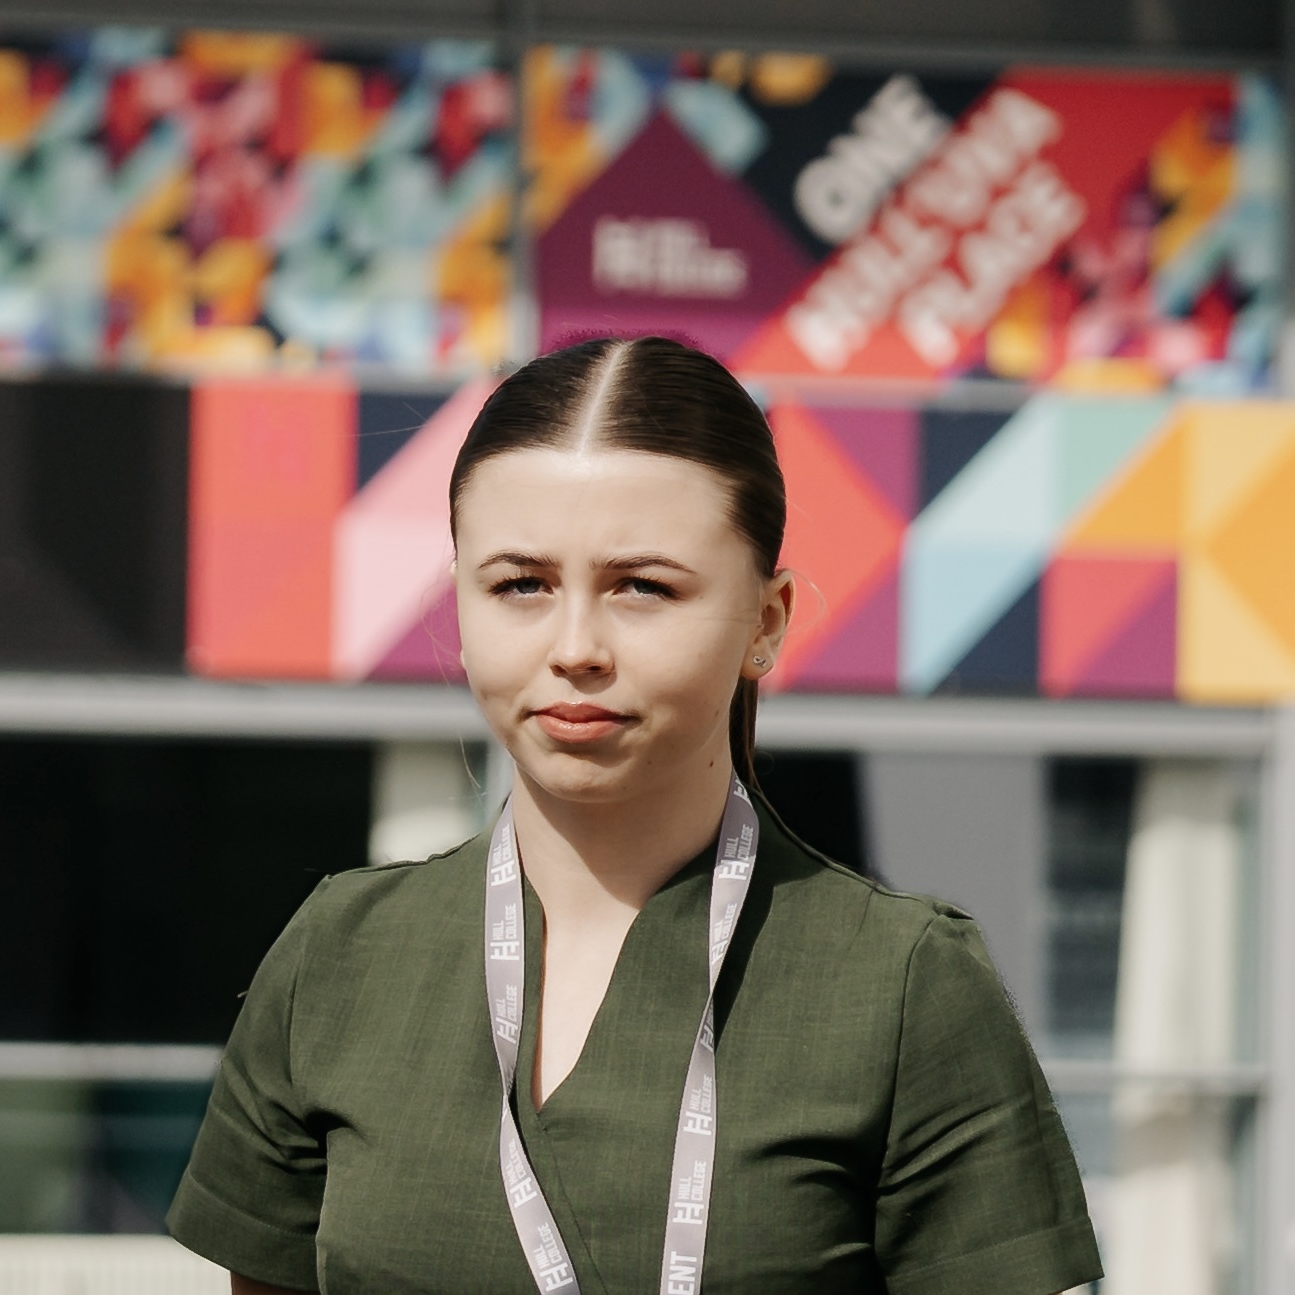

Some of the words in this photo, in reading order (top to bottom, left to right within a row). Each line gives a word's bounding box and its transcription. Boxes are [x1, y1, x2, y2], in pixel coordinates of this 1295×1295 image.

[724, 836, 740, 859] HULL
[736, 823, 754, 861] COLLEGE
[492, 920, 505, 941] HULL
[504, 903, 517, 940] COLLEGE
[722, 902, 738, 939] COLLEGE
[495, 998, 507, 1019] HULL
[505, 984, 518, 1022] COLLEGE
[689, 1088, 702, 1111] HULL
[700, 1074, 713, 1114] COLLEGE
[504, 1163, 520, 1186] HULL
[677, 1175, 692, 1200] HULL
[690, 1159, 707, 1201] COLLEGE
[532, 1243, 551, 1269] HULL
[537, 1220, 563, 1265] COLLEGE
